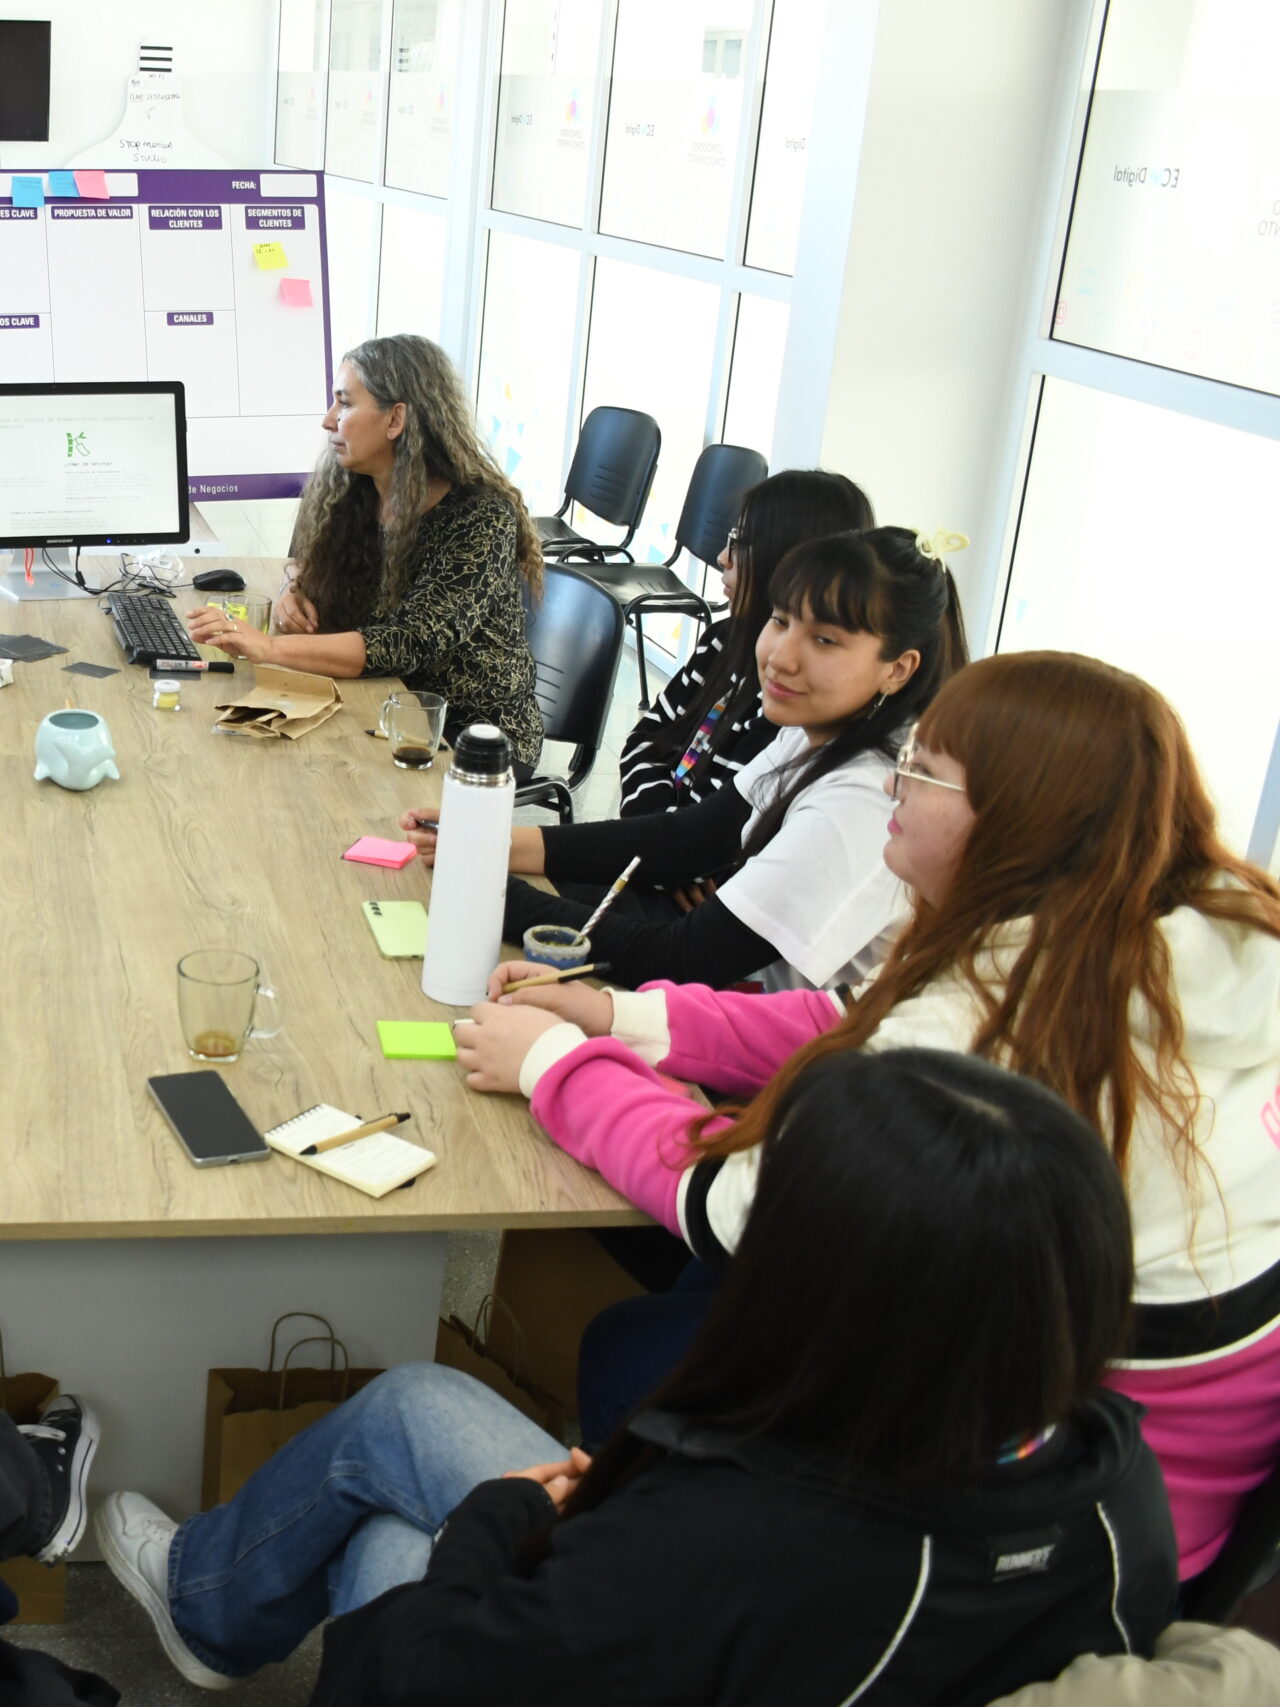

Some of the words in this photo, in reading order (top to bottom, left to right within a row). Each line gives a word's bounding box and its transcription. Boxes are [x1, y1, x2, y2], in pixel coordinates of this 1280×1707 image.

[231, 181, 257, 190] FECHA:
[11, 209, 35, 219] CLAVE
[54, 208, 96, 218] PROPUESTA
[97, 208, 108, 218] DE
[108, 208, 131, 218] VALOR
[150, 207, 187, 218] RELACIÓN
[188, 208, 204, 218] CON
[205, 208, 219, 218] LOS
[247, 208, 291, 217] SEGMENTOS
[292, 208, 303, 217] DE
[168, 219, 203, 229] CLIENTES
[258, 219, 292, 228] CLIENTES
[11, 317, 35, 326] CLAVE
[173, 314, 207, 323] CANALES
[199, 483, 239, 495] Negocios
